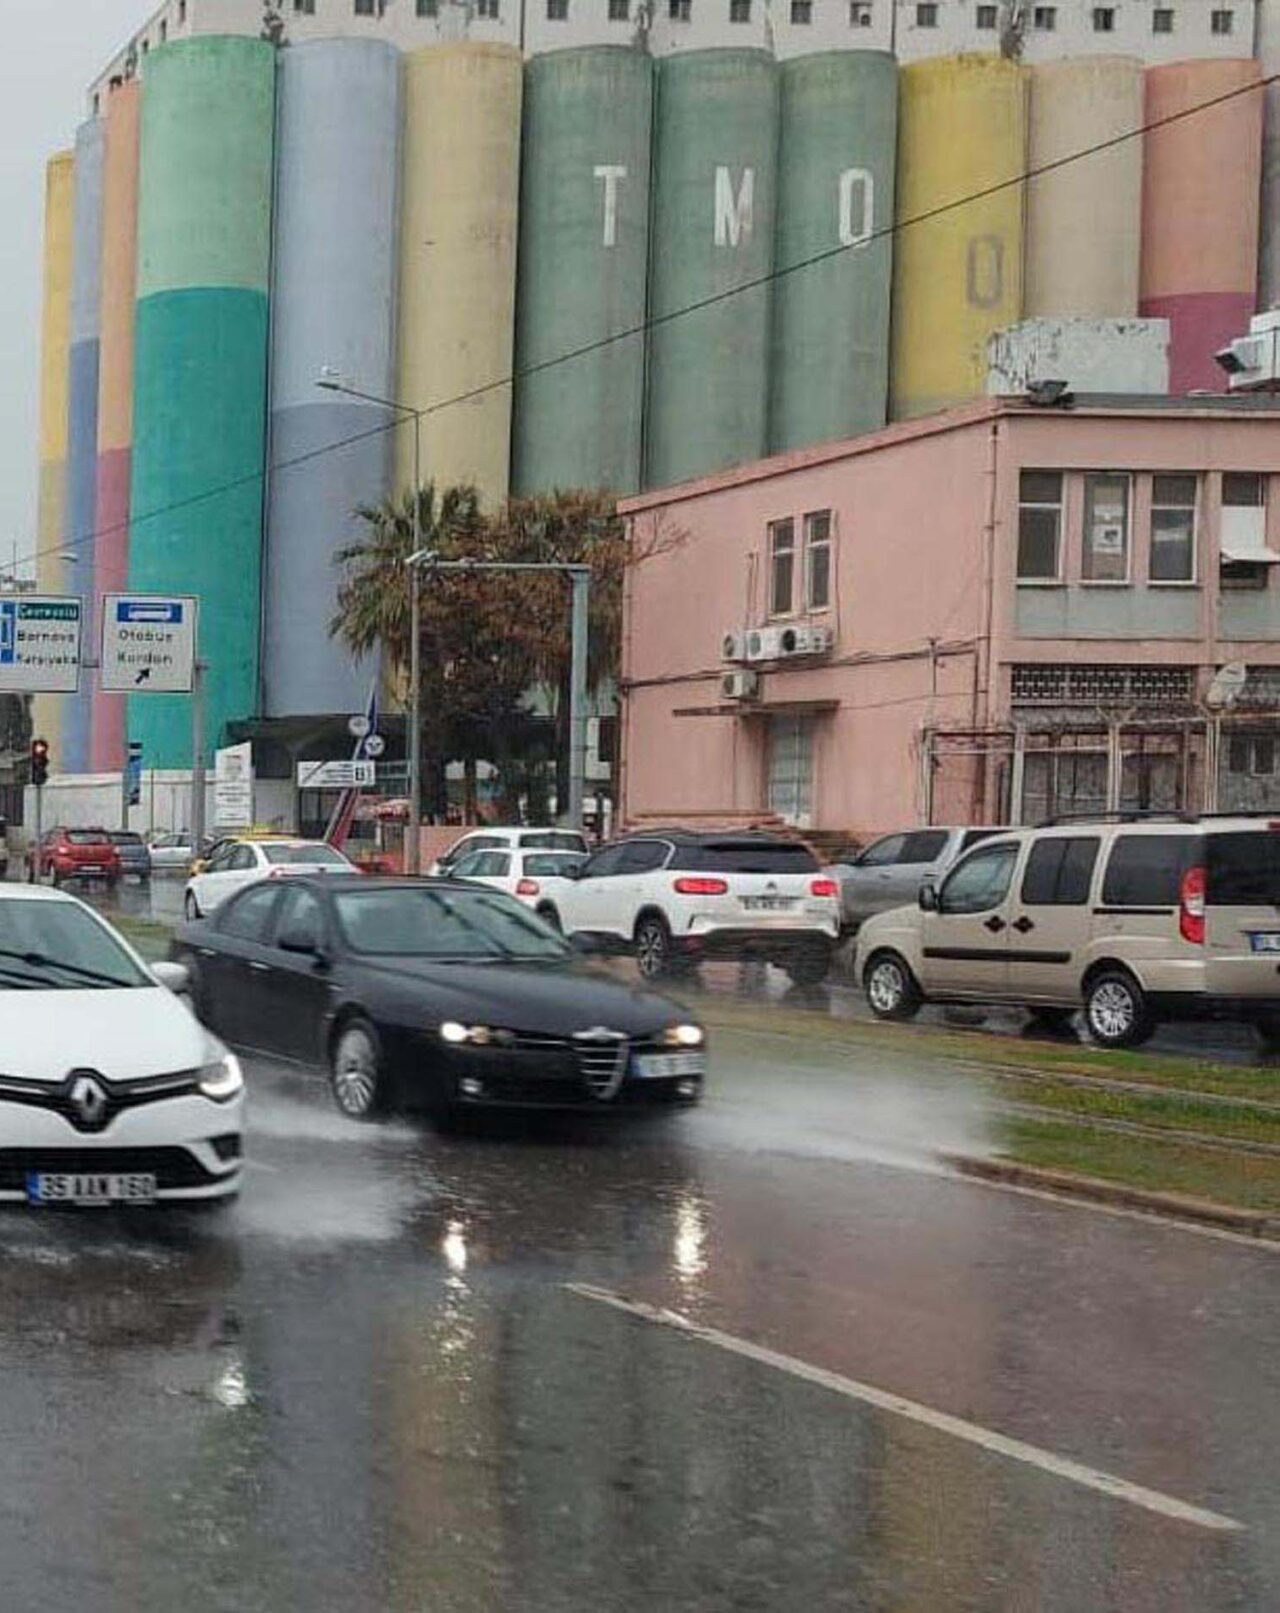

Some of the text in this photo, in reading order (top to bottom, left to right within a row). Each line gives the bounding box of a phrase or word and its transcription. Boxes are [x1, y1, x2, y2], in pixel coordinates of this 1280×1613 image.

[594, 165, 627, 246] T
[714, 166, 754, 246] M
[41, 1175, 67, 1196] 35
